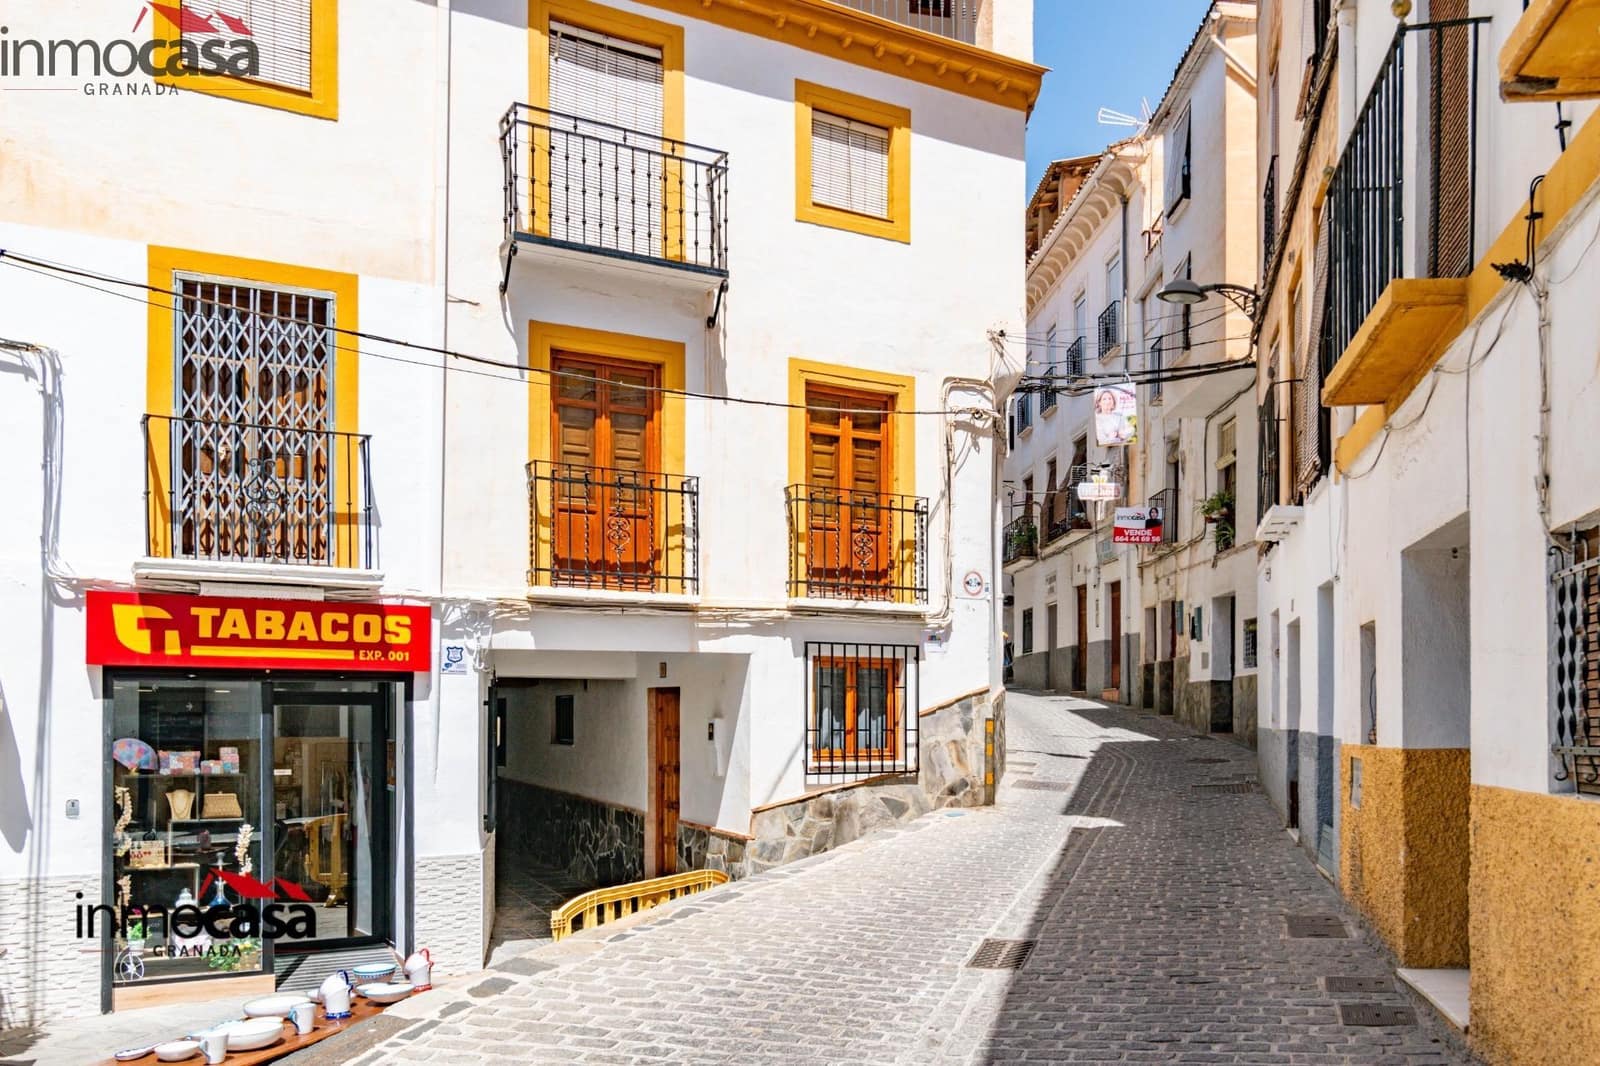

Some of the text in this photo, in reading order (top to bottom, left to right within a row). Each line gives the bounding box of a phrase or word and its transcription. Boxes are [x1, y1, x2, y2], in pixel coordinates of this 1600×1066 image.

[1124, 529, 1153, 537] VENDE
[190, 607, 412, 645] TABACOS
[359, 650, 410, 661] EXP. 001
